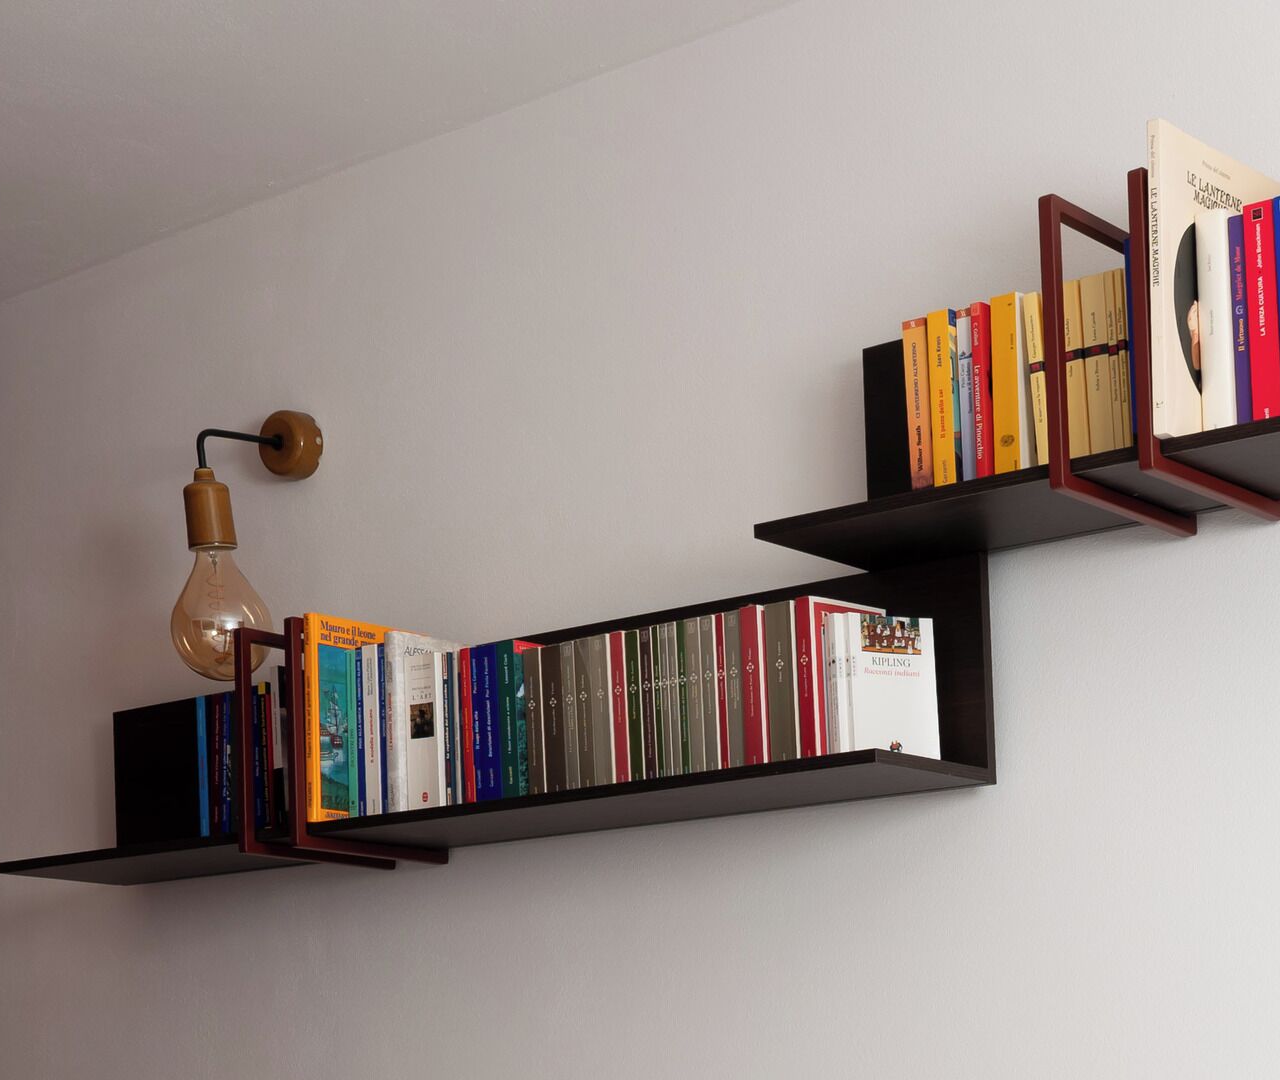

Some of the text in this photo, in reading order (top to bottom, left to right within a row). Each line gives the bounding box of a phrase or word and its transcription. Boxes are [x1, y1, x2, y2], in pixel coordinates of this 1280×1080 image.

[1187, 170, 1243, 213] LE LANTERNE
[1150, 188, 1160, 287] LE LANTERNE MAGICHE
[1260, 328, 1266, 337] LA
[974, 365, 984, 460] Le avventure di Pinocchio
[916, 448, 924, 472] Wilbur
[320, 620, 346, 634] Mauro
[346, 628, 351, 636] e
[352, 626, 357, 638] il
[358, 627, 377, 640] leone
[320, 632, 359, 647] nel grande
[864, 666, 921, 677] Racconti indiani
[872, 656, 911, 668] KIPLING
